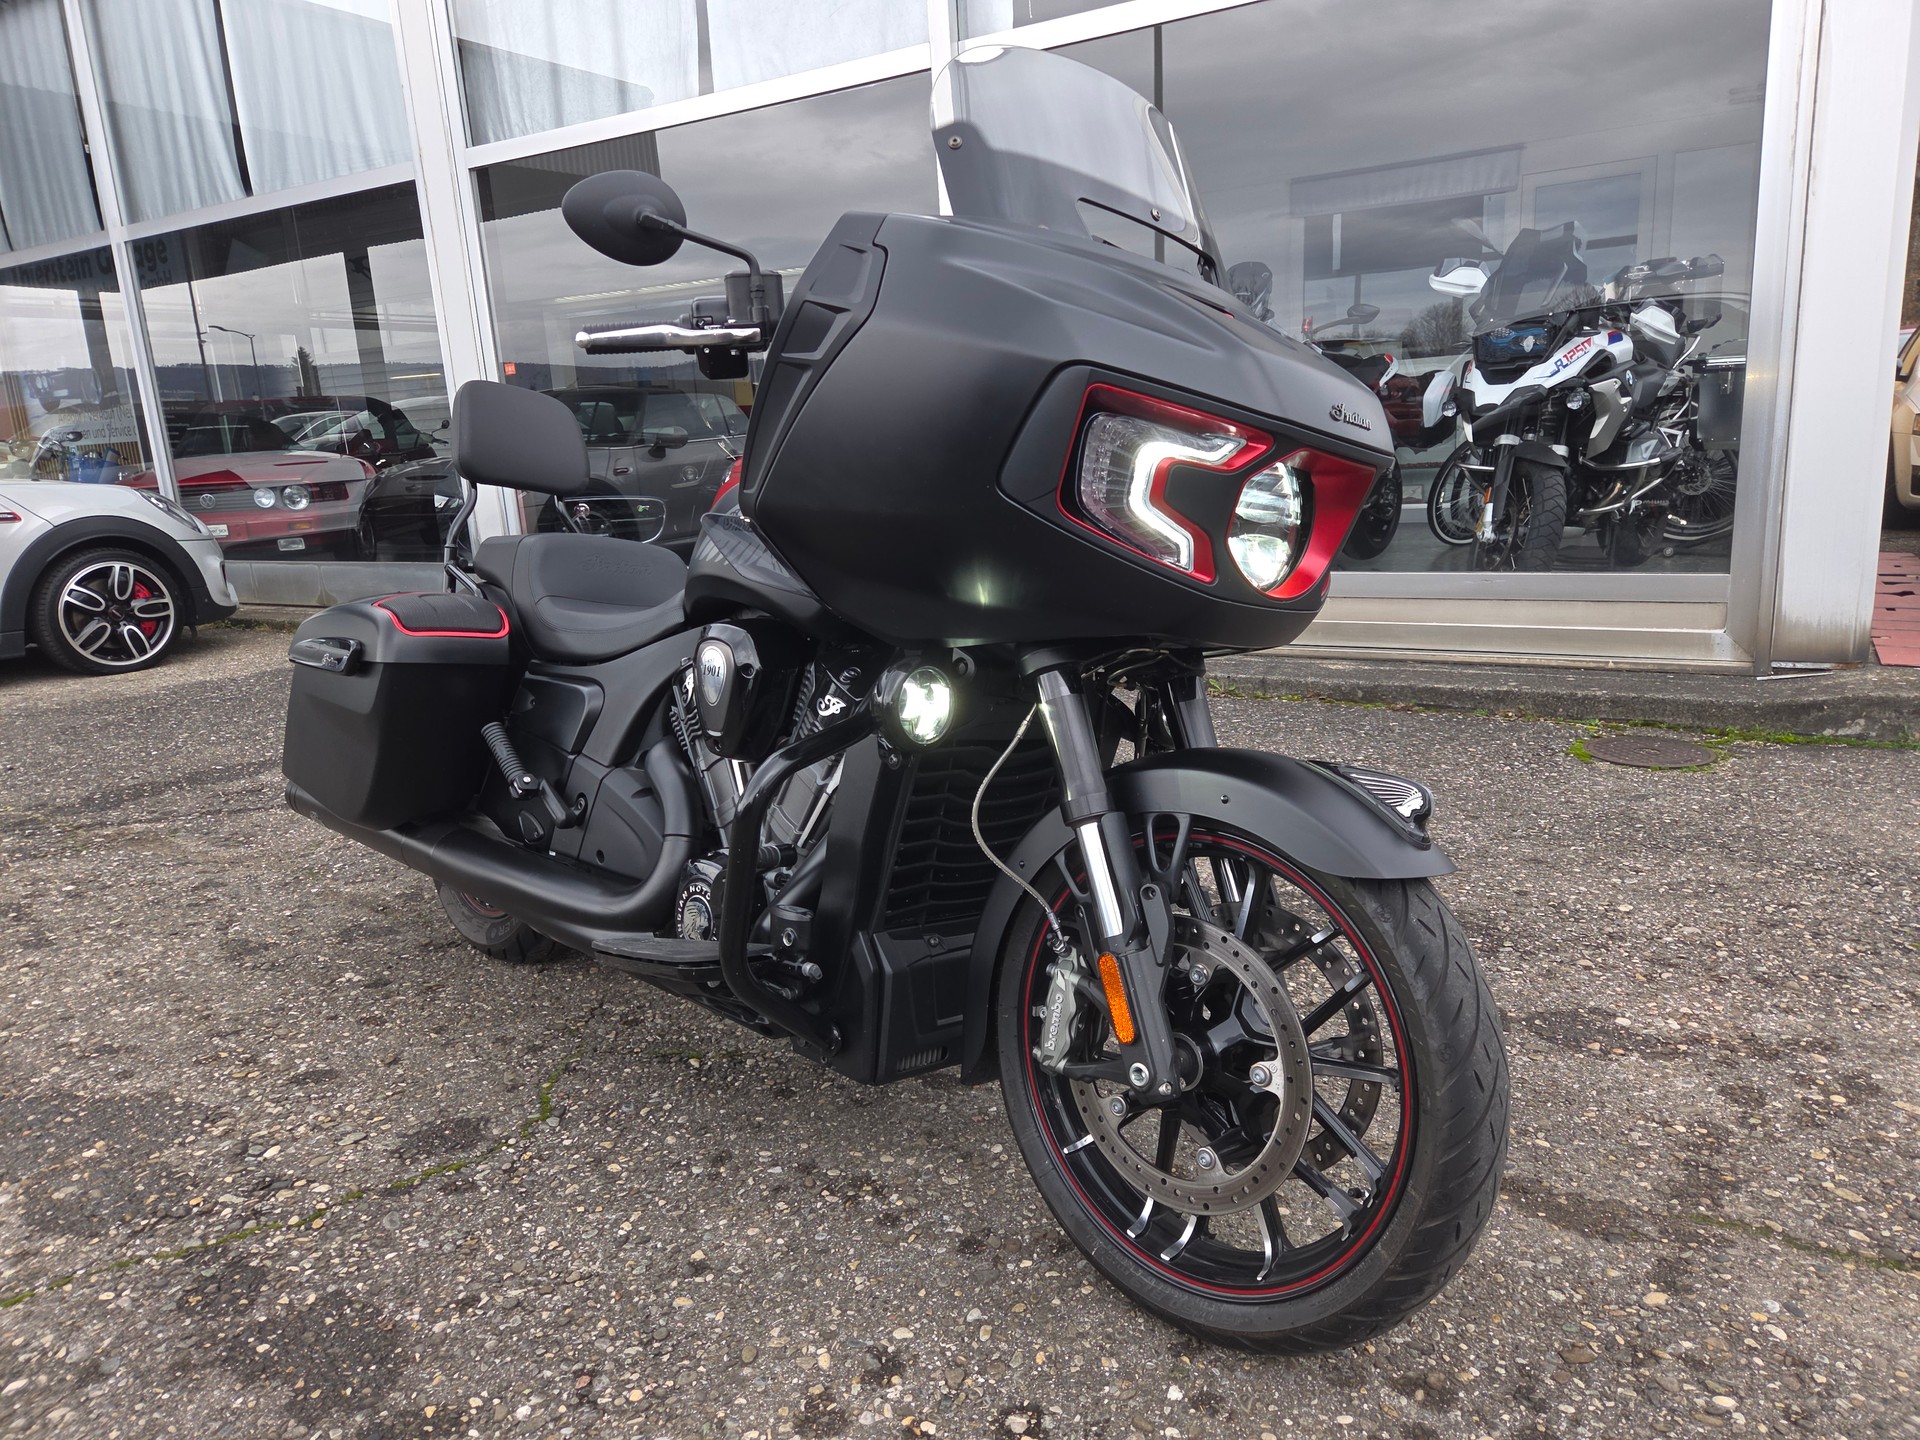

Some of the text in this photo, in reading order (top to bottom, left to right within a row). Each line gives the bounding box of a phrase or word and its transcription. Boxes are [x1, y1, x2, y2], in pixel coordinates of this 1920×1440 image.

[1329, 402, 1372, 431] Indian
[703, 664, 721, 678] 1901
[1044, 993, 1065, 1051] brembo
